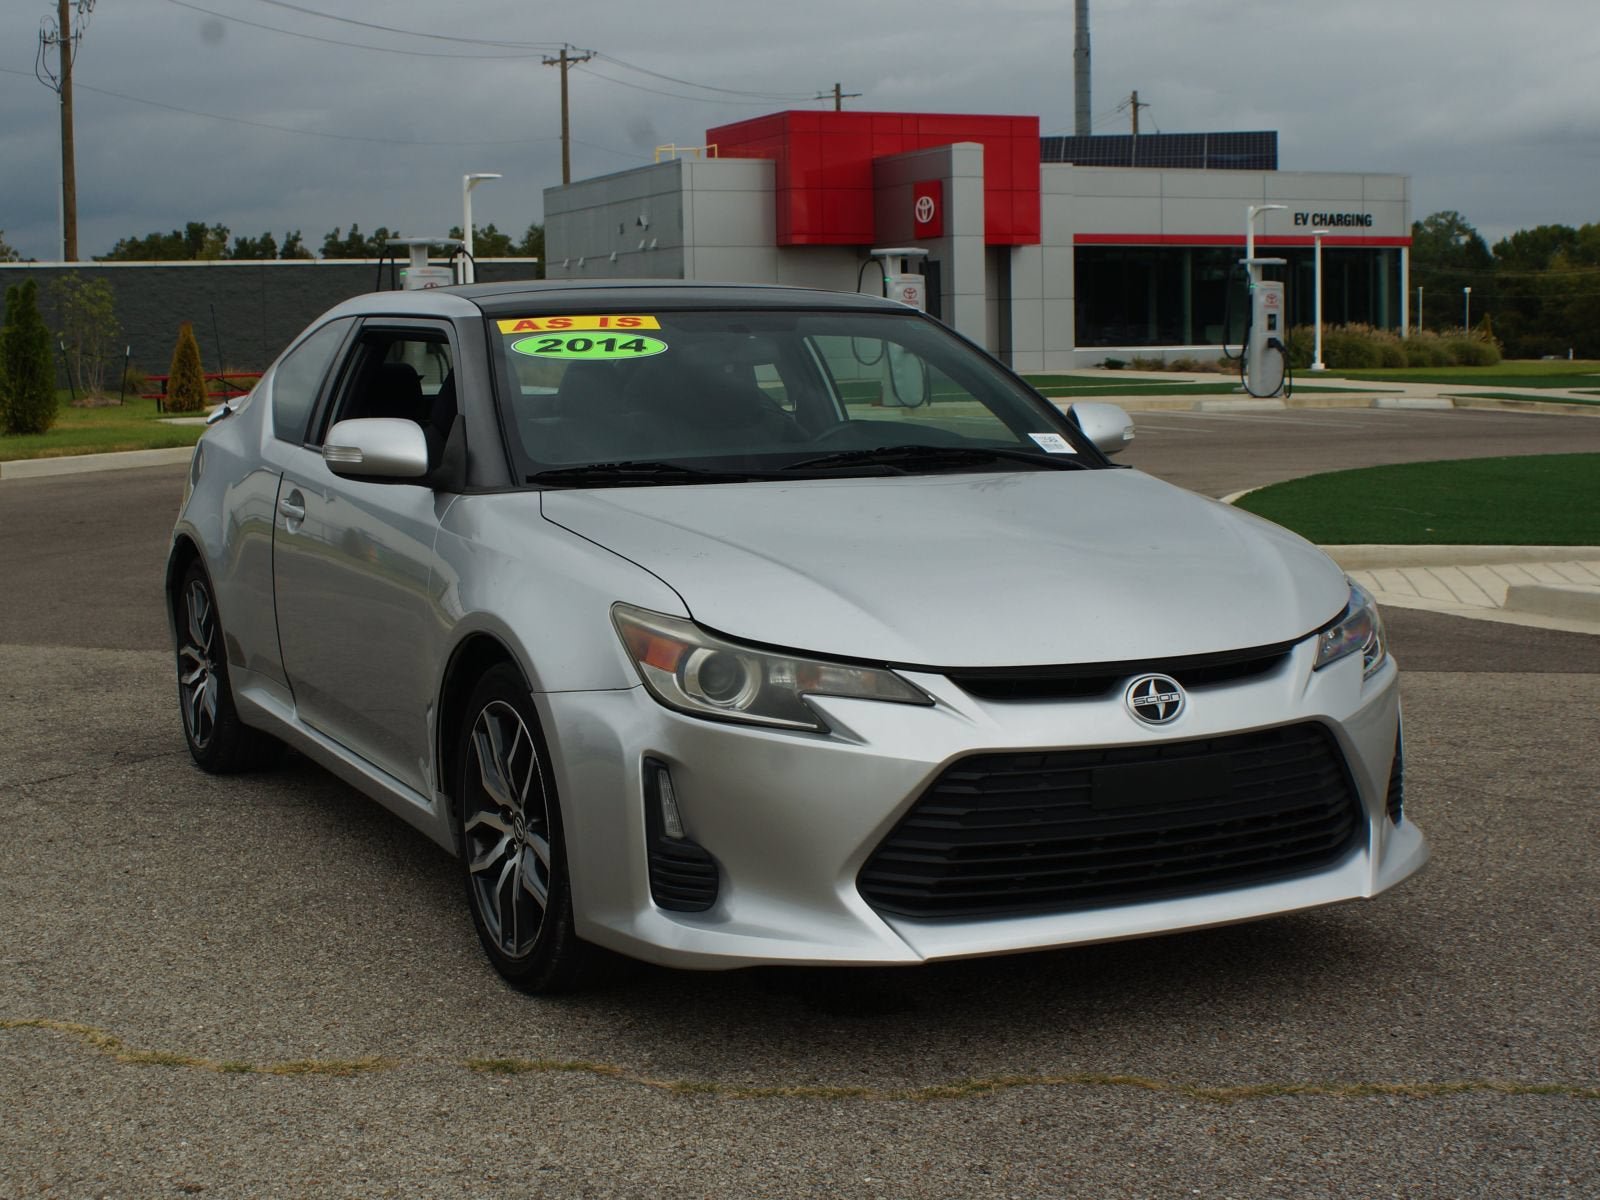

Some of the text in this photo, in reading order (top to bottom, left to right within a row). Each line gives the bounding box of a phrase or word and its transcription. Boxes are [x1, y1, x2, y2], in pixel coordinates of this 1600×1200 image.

[1294, 212, 1373, 227] EV CHARGING
[511, 316, 643, 332] AS IS
[535, 337, 647, 353] 2014
[1133, 692, 1181, 706] SCION
